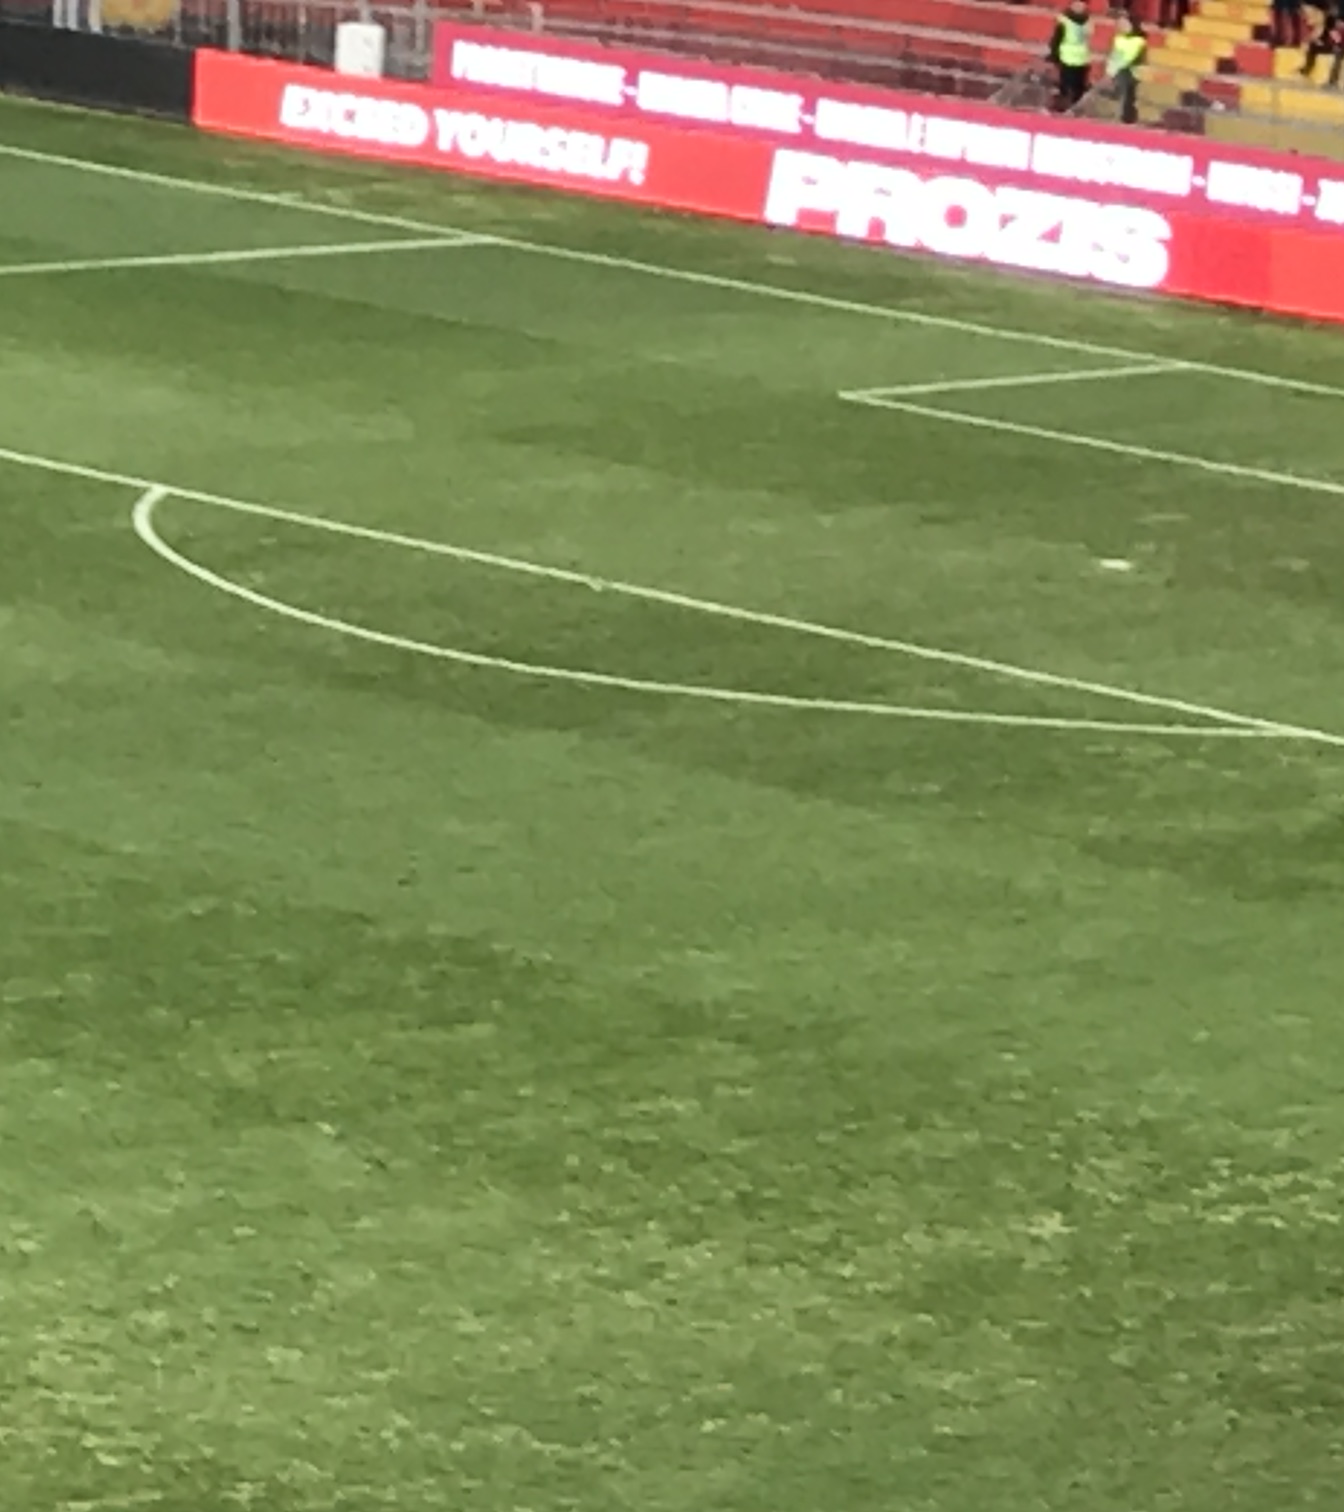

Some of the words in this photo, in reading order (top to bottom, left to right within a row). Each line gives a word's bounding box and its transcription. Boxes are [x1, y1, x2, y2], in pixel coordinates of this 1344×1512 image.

[280, 84, 429, 148] EXCEED
[432, 107, 649, 187] YOURSELF!
[766, 149, 1172, 289] PROZIS
